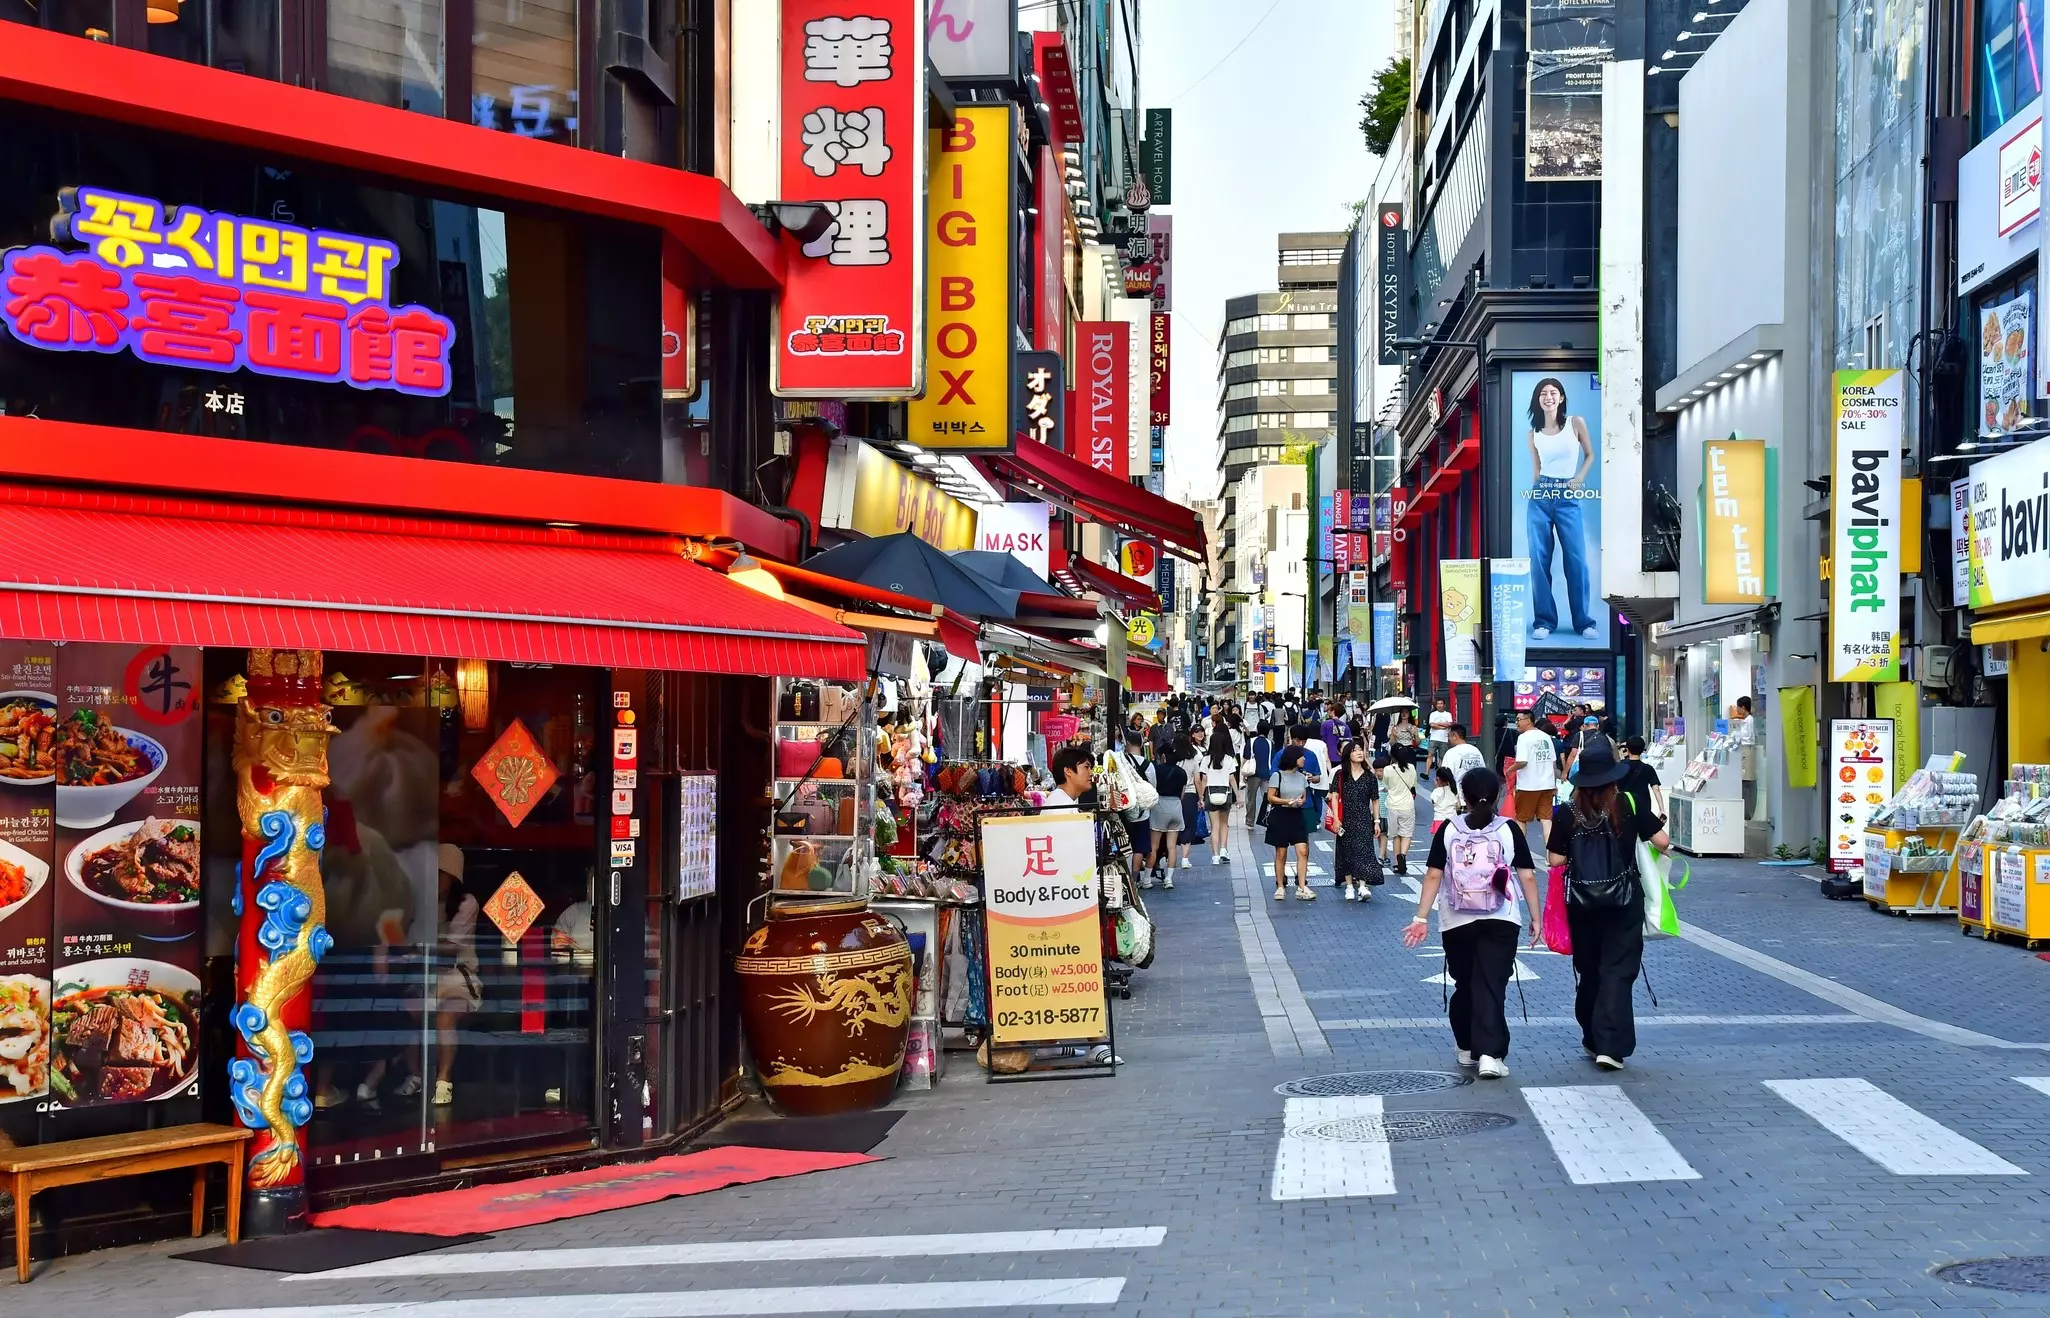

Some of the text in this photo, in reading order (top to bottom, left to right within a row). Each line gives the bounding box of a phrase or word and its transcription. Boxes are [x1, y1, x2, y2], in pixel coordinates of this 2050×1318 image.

[1153, 112, 1163, 201] ARTRAVEL HOME
[1128, 213, 1149, 258] 明洞
[936, 116, 976, 406] BIG BOX
[1123, 269, 1151, 282] Mud
[1125, 281, 1151, 289] SAUNA
[1384, 232, 1398, 357] HOTEL SKYPARK
[1287, 303, 1316, 311] Nine
[6, 251, 448, 392] 恭喜面館
[1091, 332, 1113, 432] ROYAL
[1842, 386, 1876, 396] KOREA
[204, 391, 246, 416] 本店
[1841, 398, 1899, 407] COSMETICS
[1154, 412, 1169, 423] 3F
[1841, 409, 1888, 419] 70%~30%
[932, 419, 986, 435] 빅박스
[1841, 420, 1867, 430] SALE
[1520, 489, 1602, 500] WEAR COOL
[1973, 481, 1988, 504] KOREA
[2001, 471, 2050, 562] bavi
[1847, 450, 1889, 612] baviphat
[985, 533, 1044, 551] MASK
[1973, 566, 1985, 587] SALE
[1161, 563, 1171, 609] MEDIHEAL
[1133, 619, 1147, 634] 光
[1871, 631, 1891, 641] 韩国
[1842, 644, 1891, 655] 有名化妆品
[1855, 657, 1889, 668] 7~3 折
[140, 653, 192, 716] 牛
[1896, 720, 1906, 738] cool
[1897, 740, 1906, 751] for
[1535, 751, 1551, 761] 1992
[1898, 754, 1908, 782] school
[1703, 807, 1718, 816] All
[1698, 817, 1720, 825] Mask
[615, 844, 632, 852] VISA
[1022, 835, 1059, 878] 足
[994, 884, 1090, 906] Body&Foot
[1965, 892, 1977, 908] SALE
[1010, 944, 1080, 958] 30 minute
[995, 965, 1048, 980] Body(身)
[996, 984, 1049, 997] Foot(足)
[998, 1008, 1100, 1026] 02-318-5877
